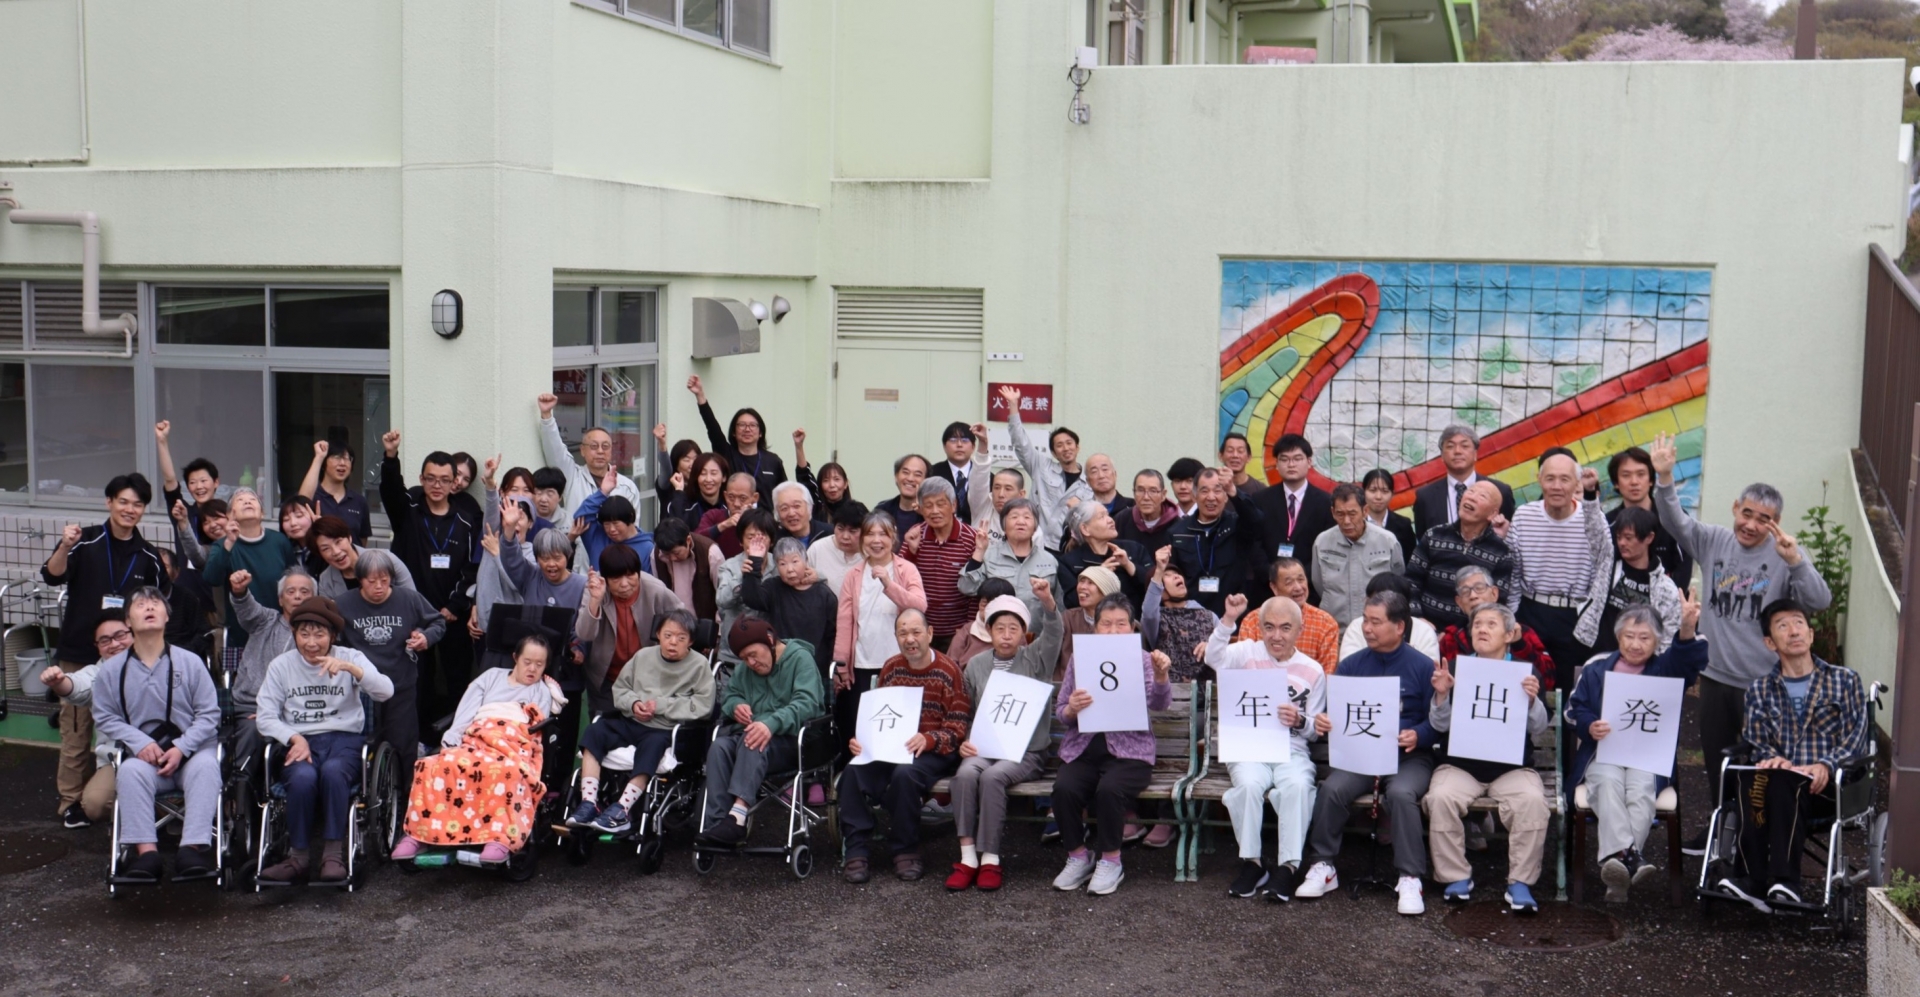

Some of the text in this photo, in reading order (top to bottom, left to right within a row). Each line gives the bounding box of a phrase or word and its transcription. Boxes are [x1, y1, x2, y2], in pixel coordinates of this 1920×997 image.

[992, 396, 1049, 411] 火厳禁
[353, 616, 403, 629] NASHVILLE
[1099, 660, 1119, 692] 8
[869, 703, 904, 733] 令
[990, 692, 1027, 727] 和
[1234, 690, 1271, 728] 年
[1342, 699, 1383, 739] 度
[1471, 682, 1509, 724] 出
[1617, 698, 1662, 734] 発
